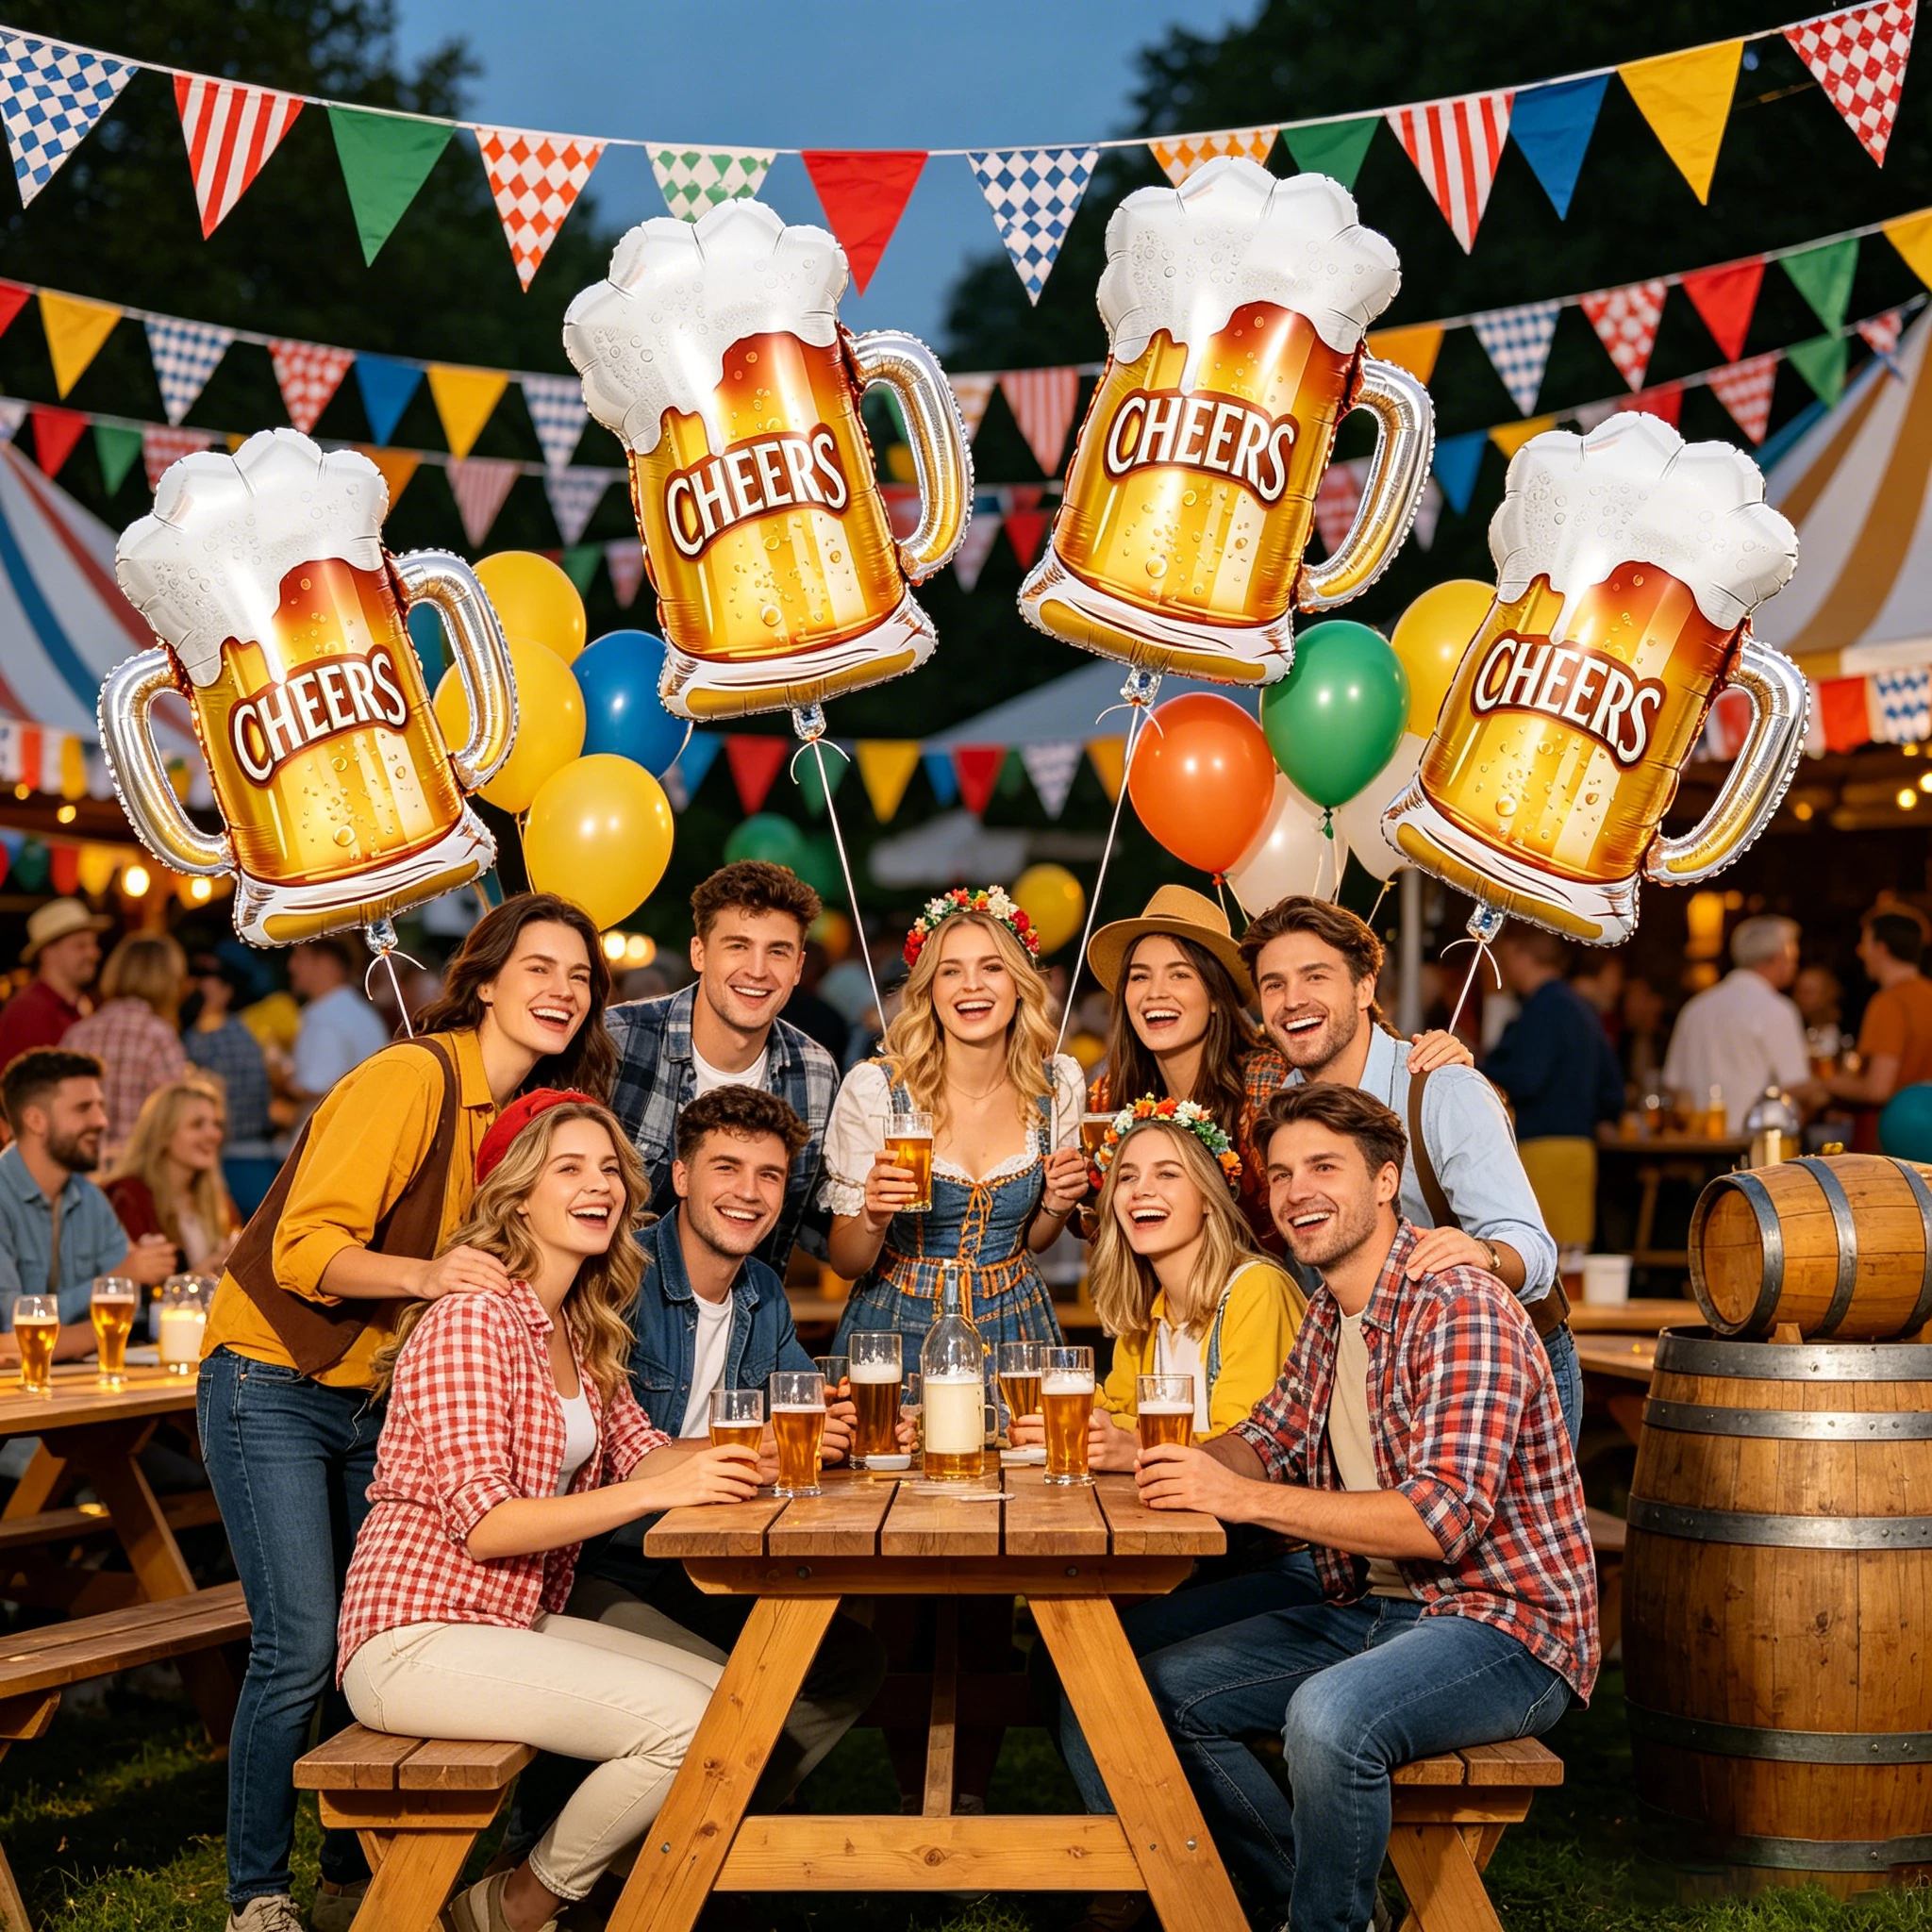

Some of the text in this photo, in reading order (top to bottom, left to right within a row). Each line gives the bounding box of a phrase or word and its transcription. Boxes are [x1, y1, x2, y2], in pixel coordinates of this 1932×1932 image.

[667, 432, 847, 556] CHEERS
[1108, 396, 1294, 501] CHEERS
[234, 652, 406, 781] CHEERS
[1474, 638, 1660, 762] CHEERS
